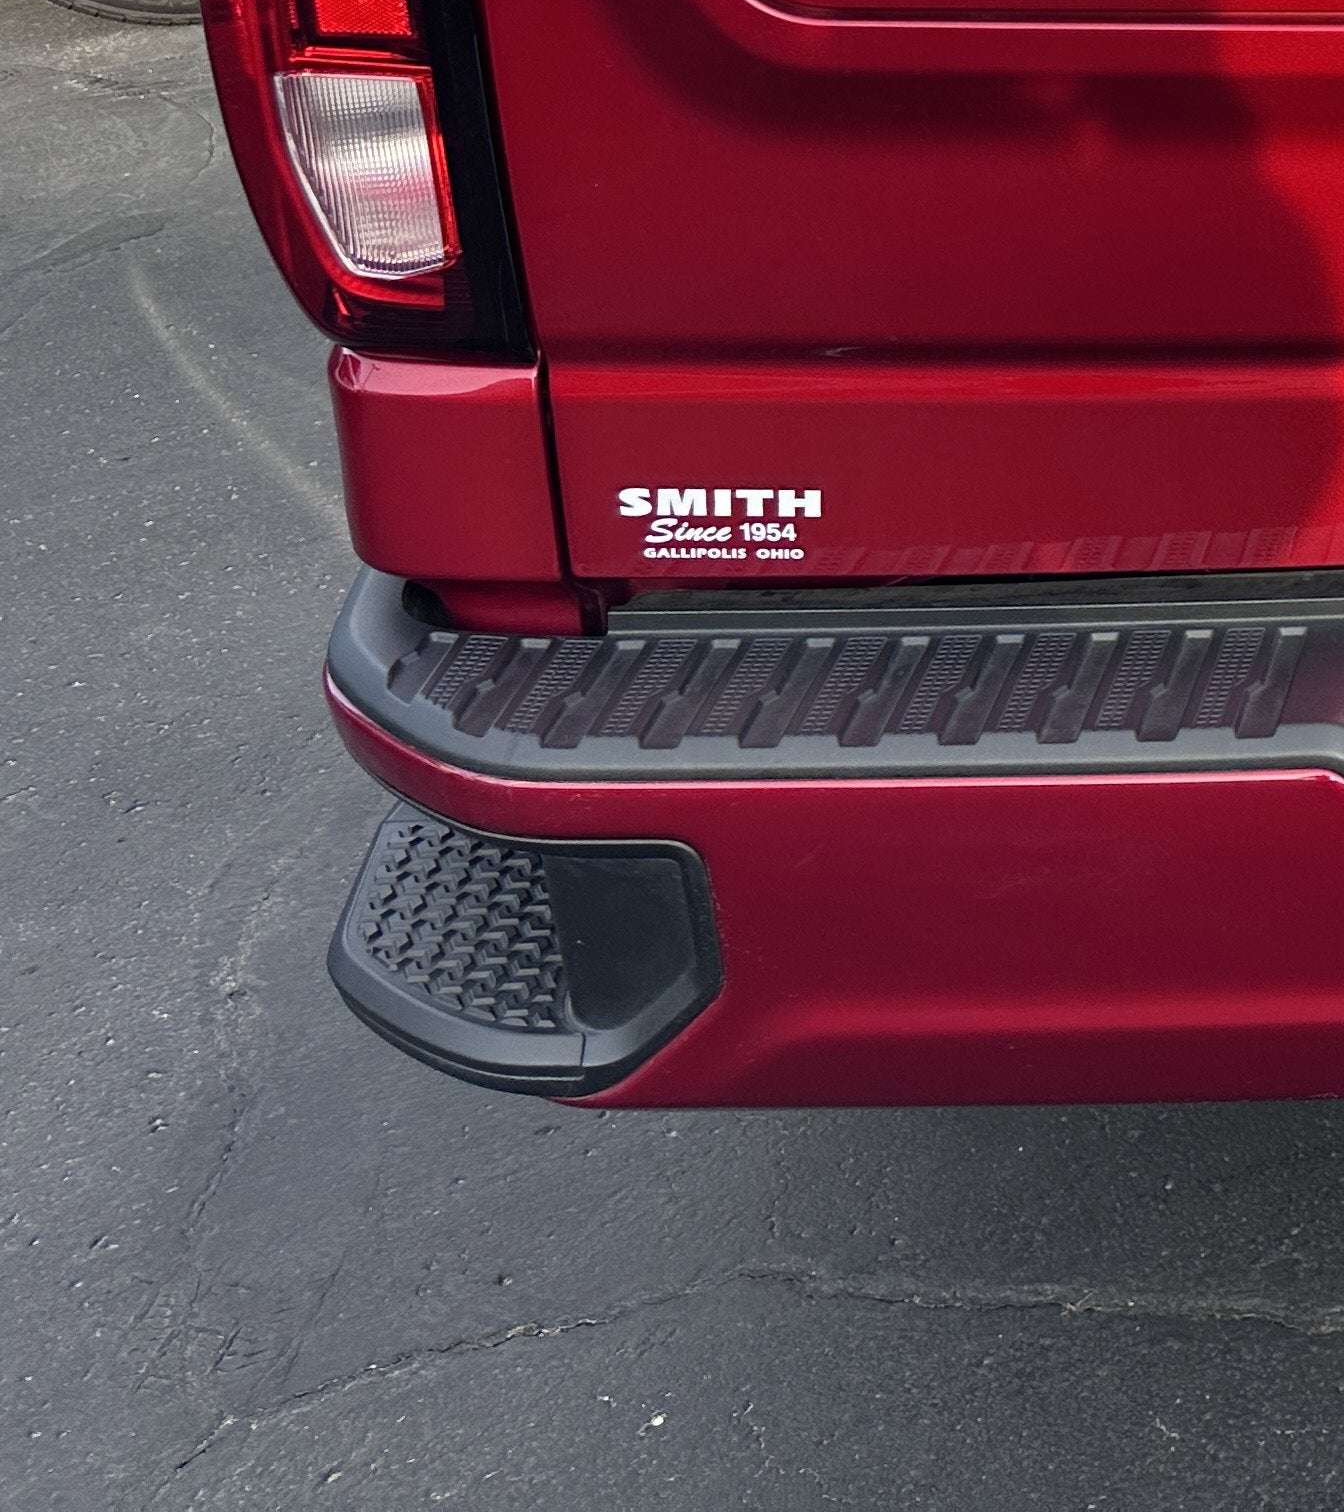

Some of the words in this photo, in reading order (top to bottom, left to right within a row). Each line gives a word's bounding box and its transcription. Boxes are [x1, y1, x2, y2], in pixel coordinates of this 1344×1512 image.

[618, 487, 822, 517] SMITH
[644, 518, 732, 543] Since
[739, 522, 797, 542] 1954
[643, 547, 747, 559] GALLIPOLIS
[755, 548, 805, 560] OHIO
